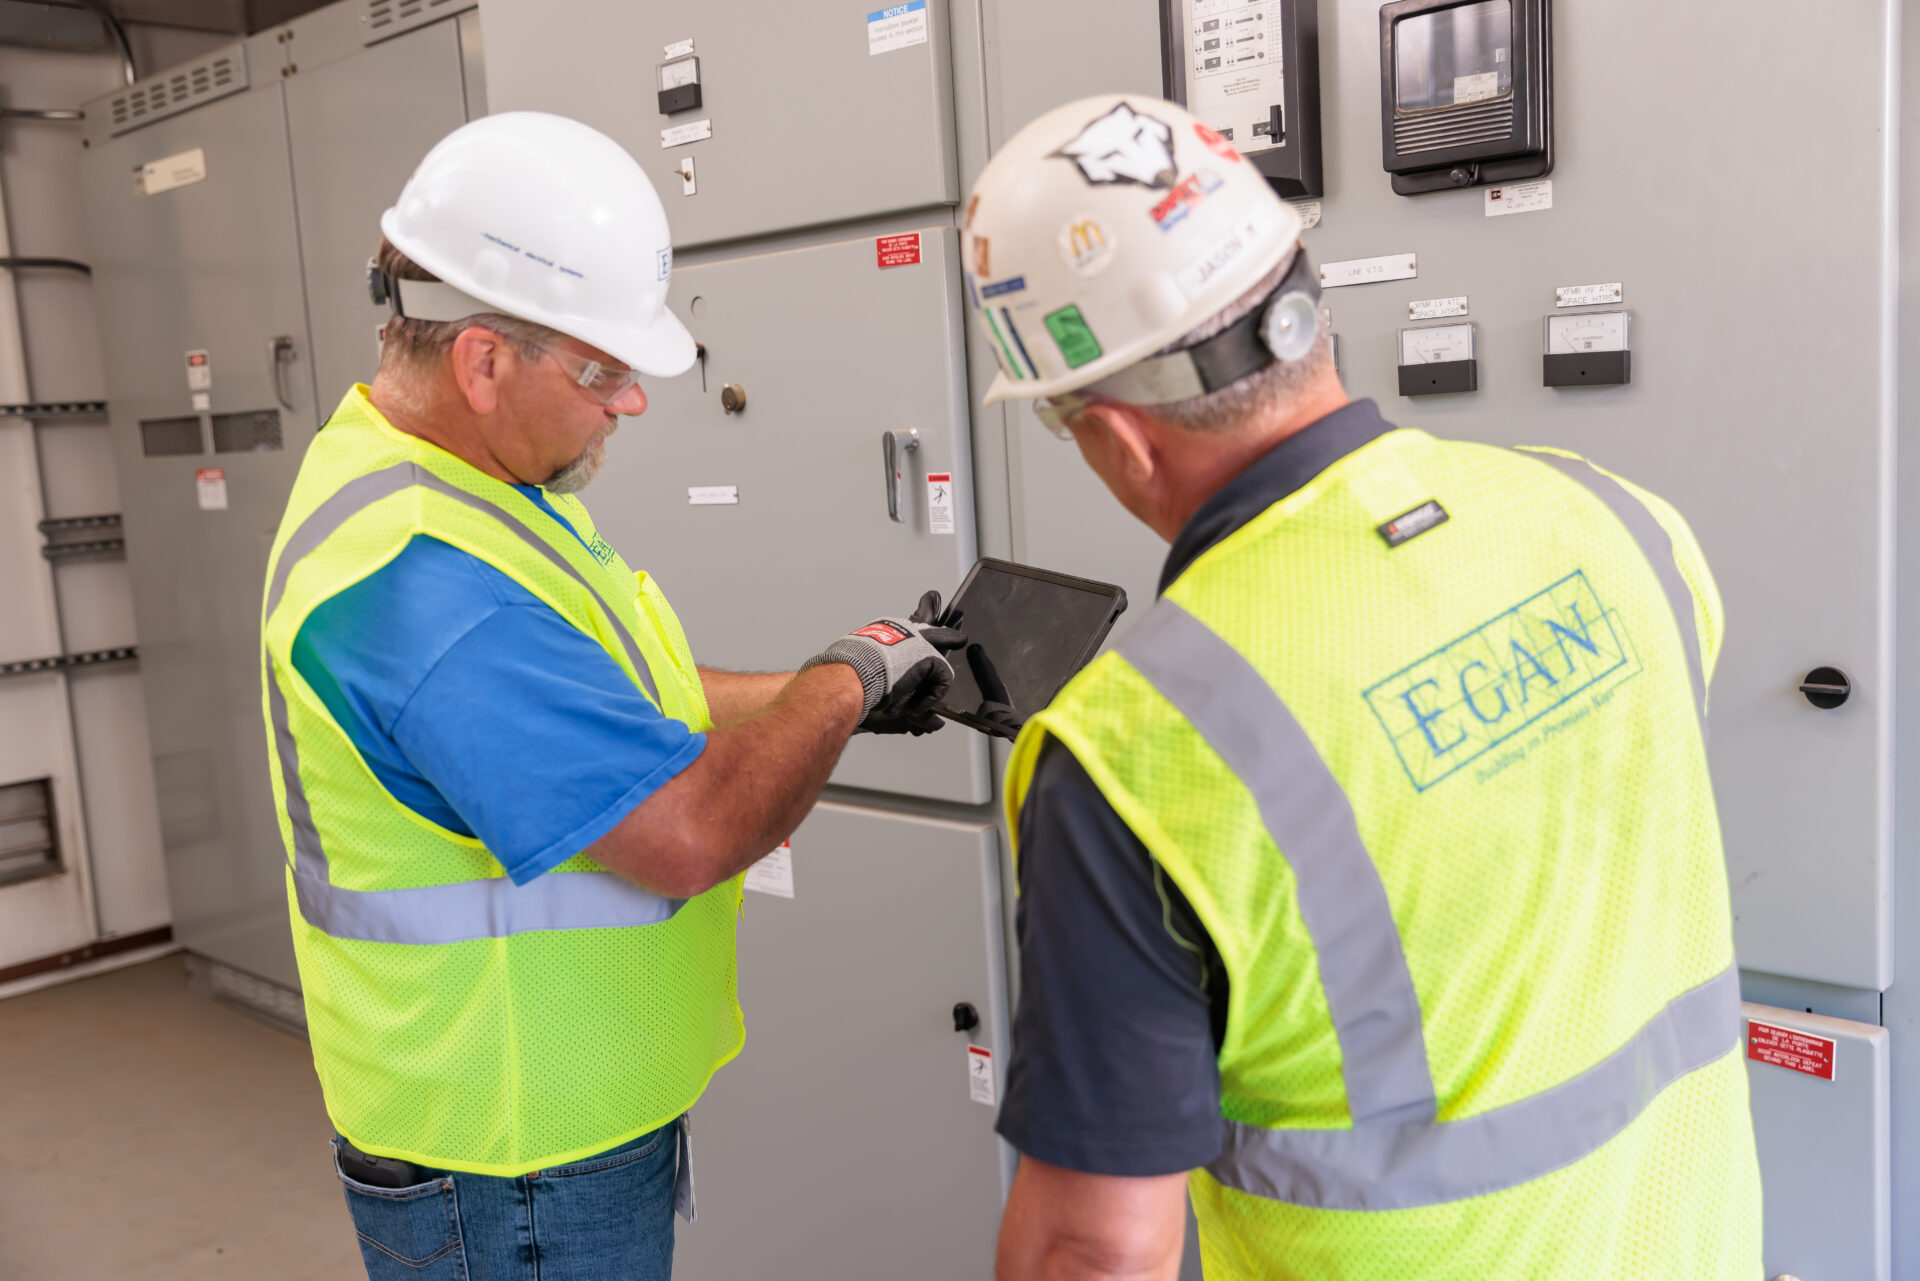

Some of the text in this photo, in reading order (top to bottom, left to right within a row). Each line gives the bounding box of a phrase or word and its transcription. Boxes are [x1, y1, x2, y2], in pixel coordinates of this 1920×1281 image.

[883, 4, 909, 19] NOTICE
[1348, 267, 1362, 277] LINE
[1562, 287, 1581, 296] XFMR
[1562, 294, 1614, 306] SPACE HTRS
[1397, 601, 1601, 758] EGAN
